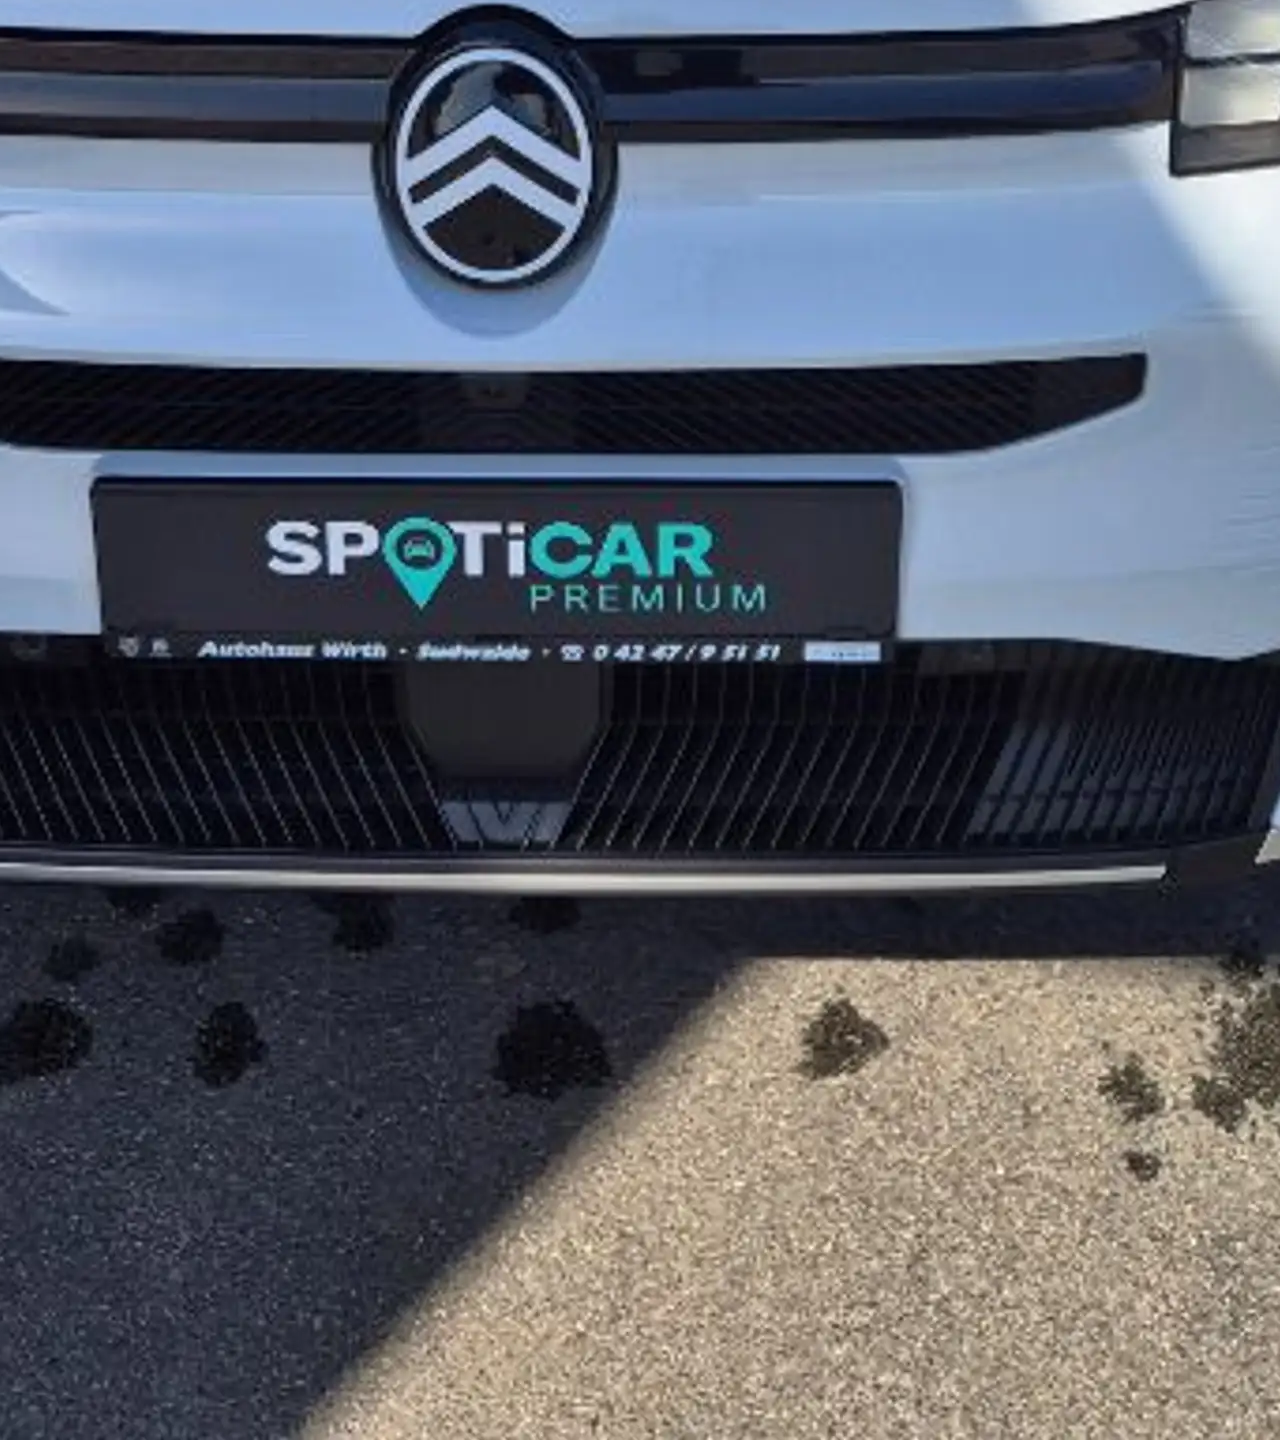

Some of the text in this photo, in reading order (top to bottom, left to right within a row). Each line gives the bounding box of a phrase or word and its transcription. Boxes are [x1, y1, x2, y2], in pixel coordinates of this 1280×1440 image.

[531, 584, 766, 613] PREMIUM
[197, 641, 315, 658] Autohaus
[321, 641, 387, 659] Wirth
